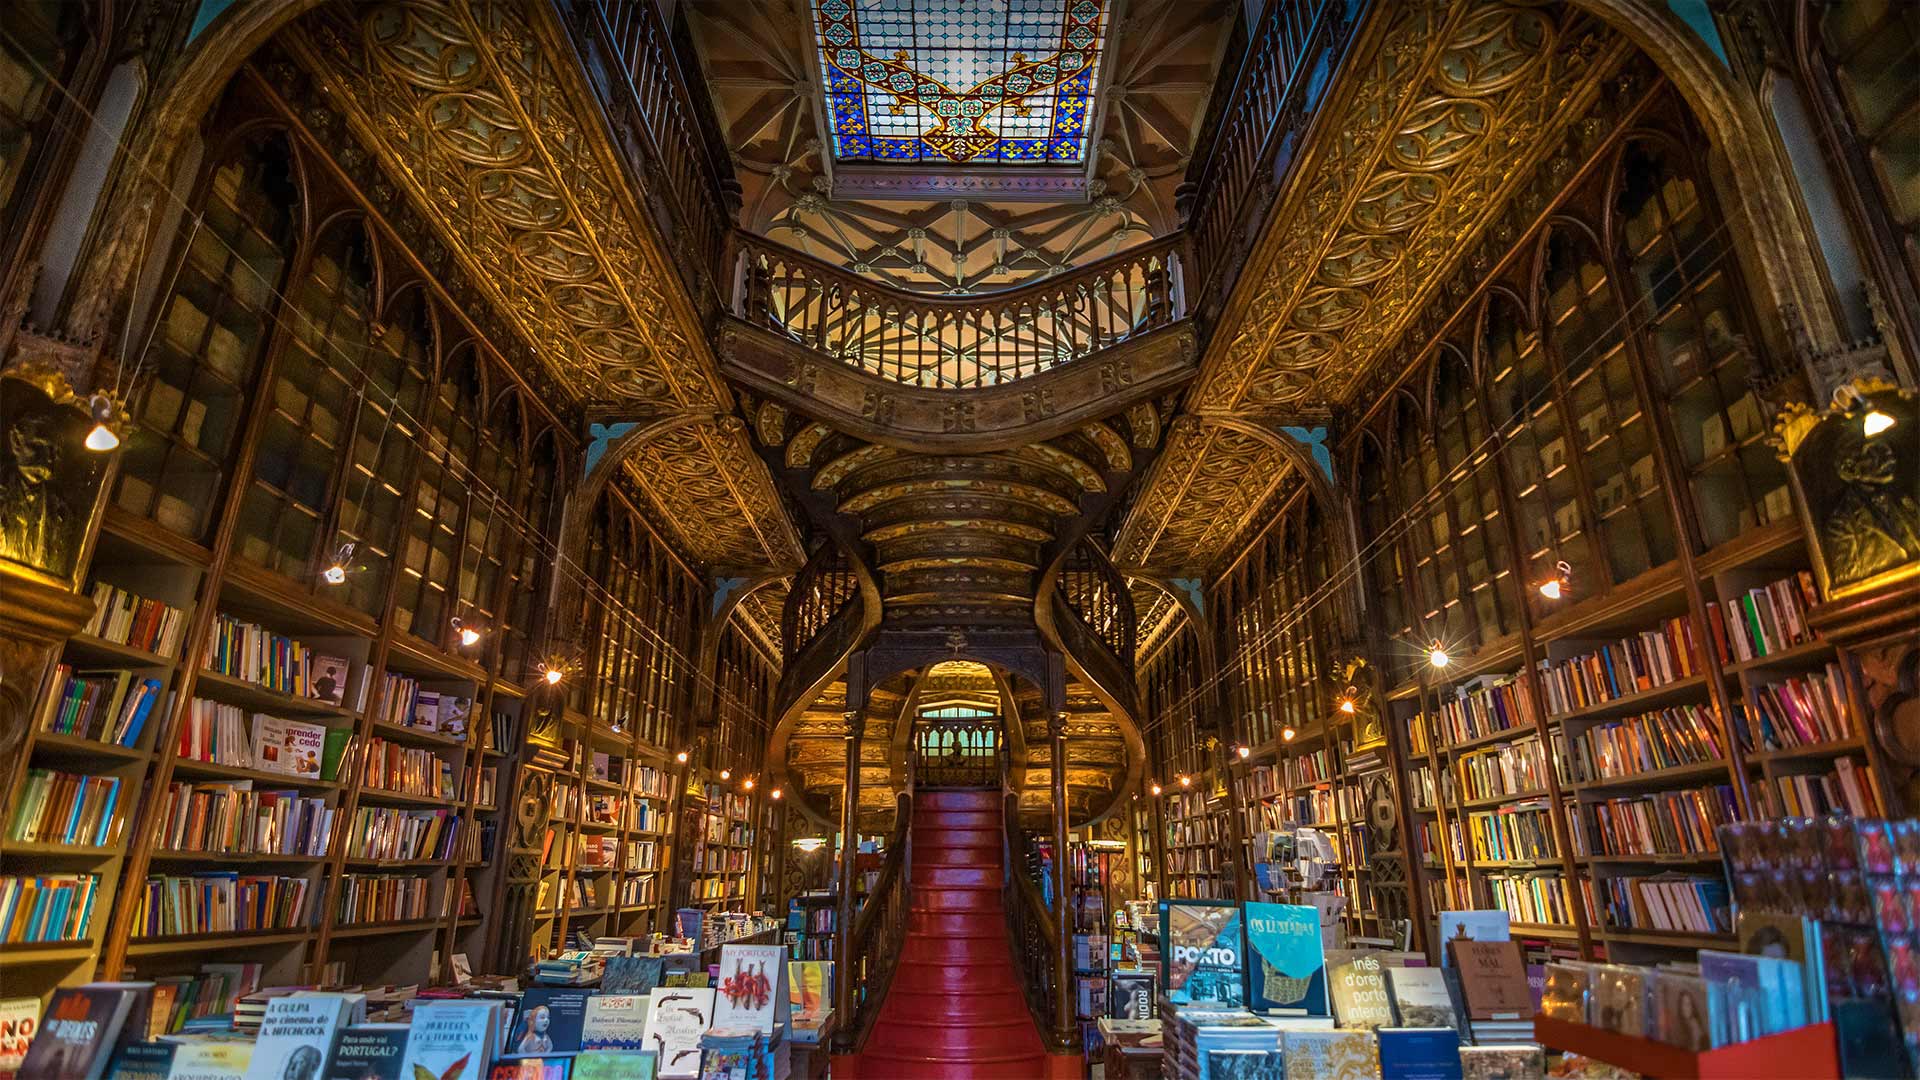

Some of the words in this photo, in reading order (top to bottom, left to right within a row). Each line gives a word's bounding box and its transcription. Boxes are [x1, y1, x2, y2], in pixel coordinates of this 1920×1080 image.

[299, 738, 321, 747] cedo
[1174, 945, 1236, 966] PORTO
[1351, 956, 1380, 971] inês
[1345, 972, 1383, 989] d'orey
[1352, 988, 1387, 1004] porto
[277, 1003, 310, 1013] CULPA
[1348, 1005, 1391, 1018] interior
[280, 1015, 315, 1025] cinema
[272, 1026, 326, 1036] HITCHCOCK
[339, 1045, 398, 1057] PORTUGAL?
